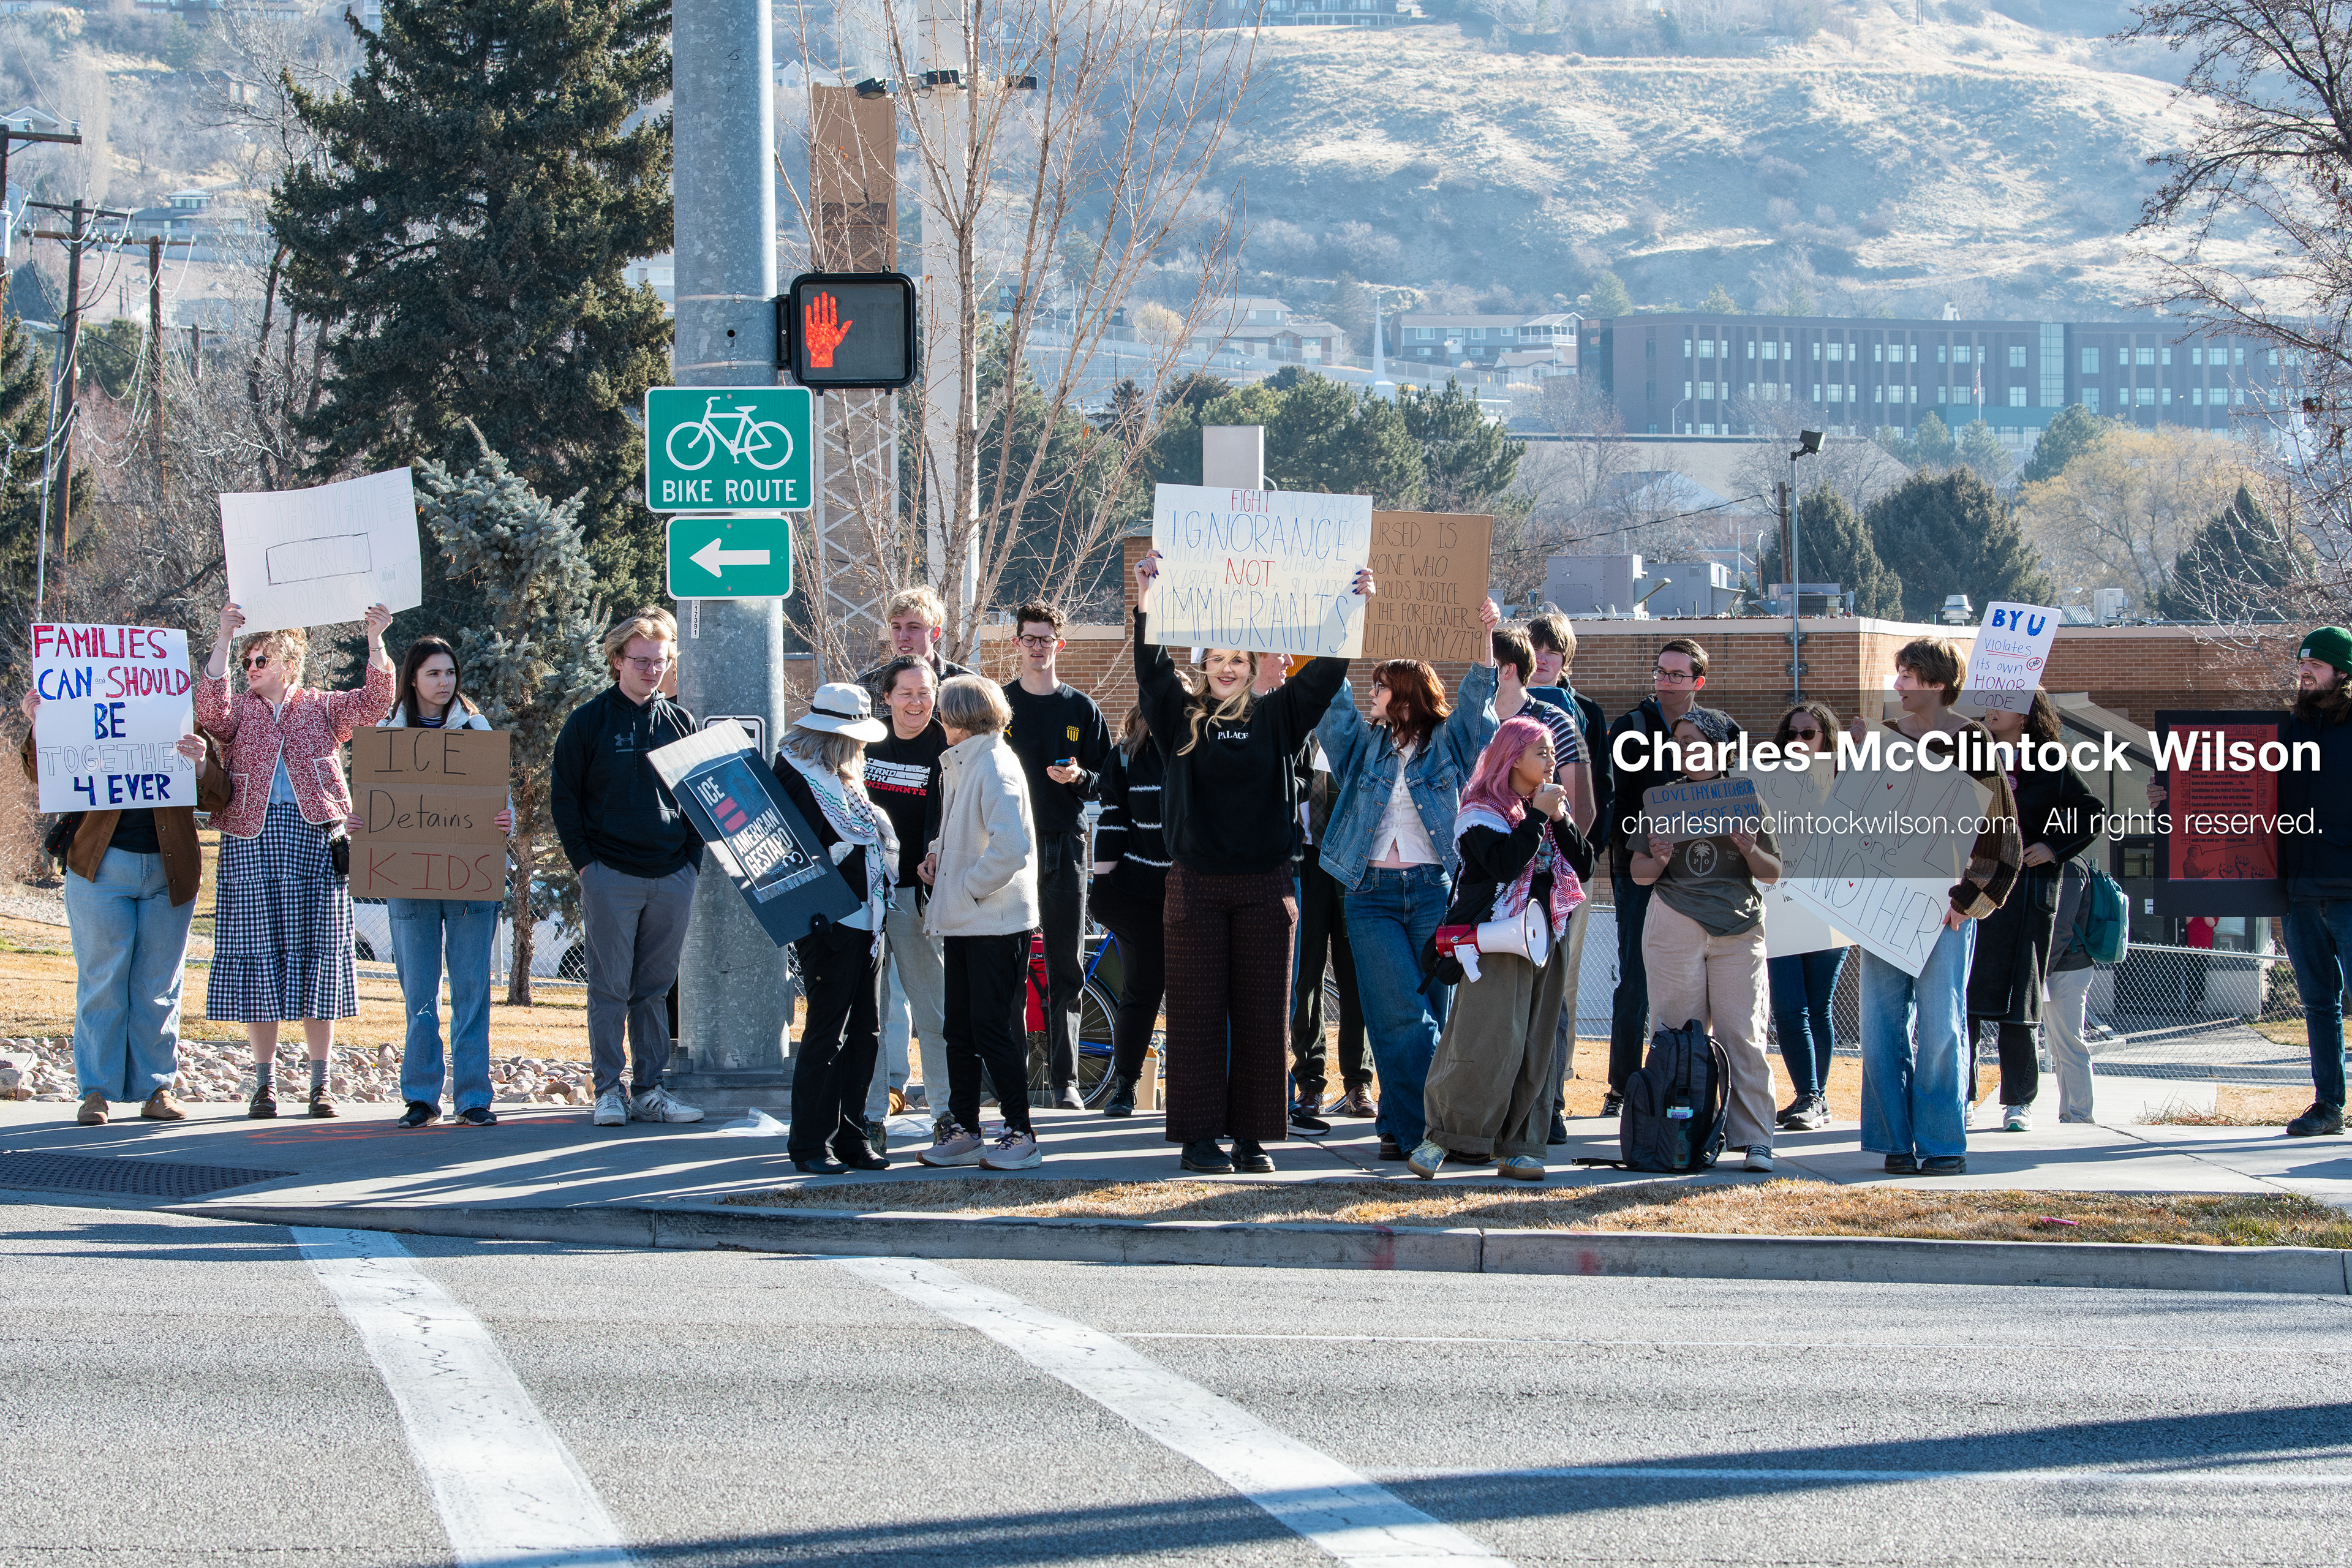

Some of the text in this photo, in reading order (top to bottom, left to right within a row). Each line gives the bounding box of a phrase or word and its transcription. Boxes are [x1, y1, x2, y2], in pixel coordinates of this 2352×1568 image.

[268, 473, 383, 543] THOUGHT
[383, 469, 415, 522] THE
[663, 479, 797, 502] BIKE ROUTE
[1231, 489, 1274, 513] FIGHT
[1172, 510, 1349, 562] IGNORANCE
[1371, 521, 1457, 549] URSED IS
[271, 533, 368, 584] WORLD
[1225, 557, 1275, 587] NOT
[1370, 553, 1449, 578] YONE WHO
[293, 576, 341, 624] OUR
[1374, 579, 1461, 605] HOLDS JUSTICE
[1161, 585, 1349, 654] IMMIGRANTS
[1376, 601, 1396, 622] THE
[32, 625, 167, 659] FAMILIES
[1363, 623, 1483, 660] UTERONOMY 27:19
[1975, 657, 2023, 675] its own
[37, 666, 191, 700] CAN and SHOULD
[1974, 674, 2026, 695] HONOR
[1973, 690, 2016, 710] CODE
[93, 702, 127, 740] BE
[1218, 730, 1249, 740] PALACE
[38, 742, 192, 776] TOGETHER
[864, 765, 897, 777] STAND
[74, 773, 171, 806] 4 EVER
[863, 780, 927, 796] MMIGRANTS
[864, 772, 886, 783] ITH
[1651, 779, 1755, 804] LOVE THY NEIGHBOR
[1754, 776, 1782, 801] ve
[368, 790, 473, 834] Detains
[1709, 805, 1728, 821] OF
[1733, 803, 1759, 817] BYU
[732, 808, 781, 856] AMERICAN
[744, 827, 794, 878] GESTAPO
[1858, 834, 1898, 868] one
[368, 847, 492, 892] KIDS
[1789, 824, 1943, 963] ANOTHER
